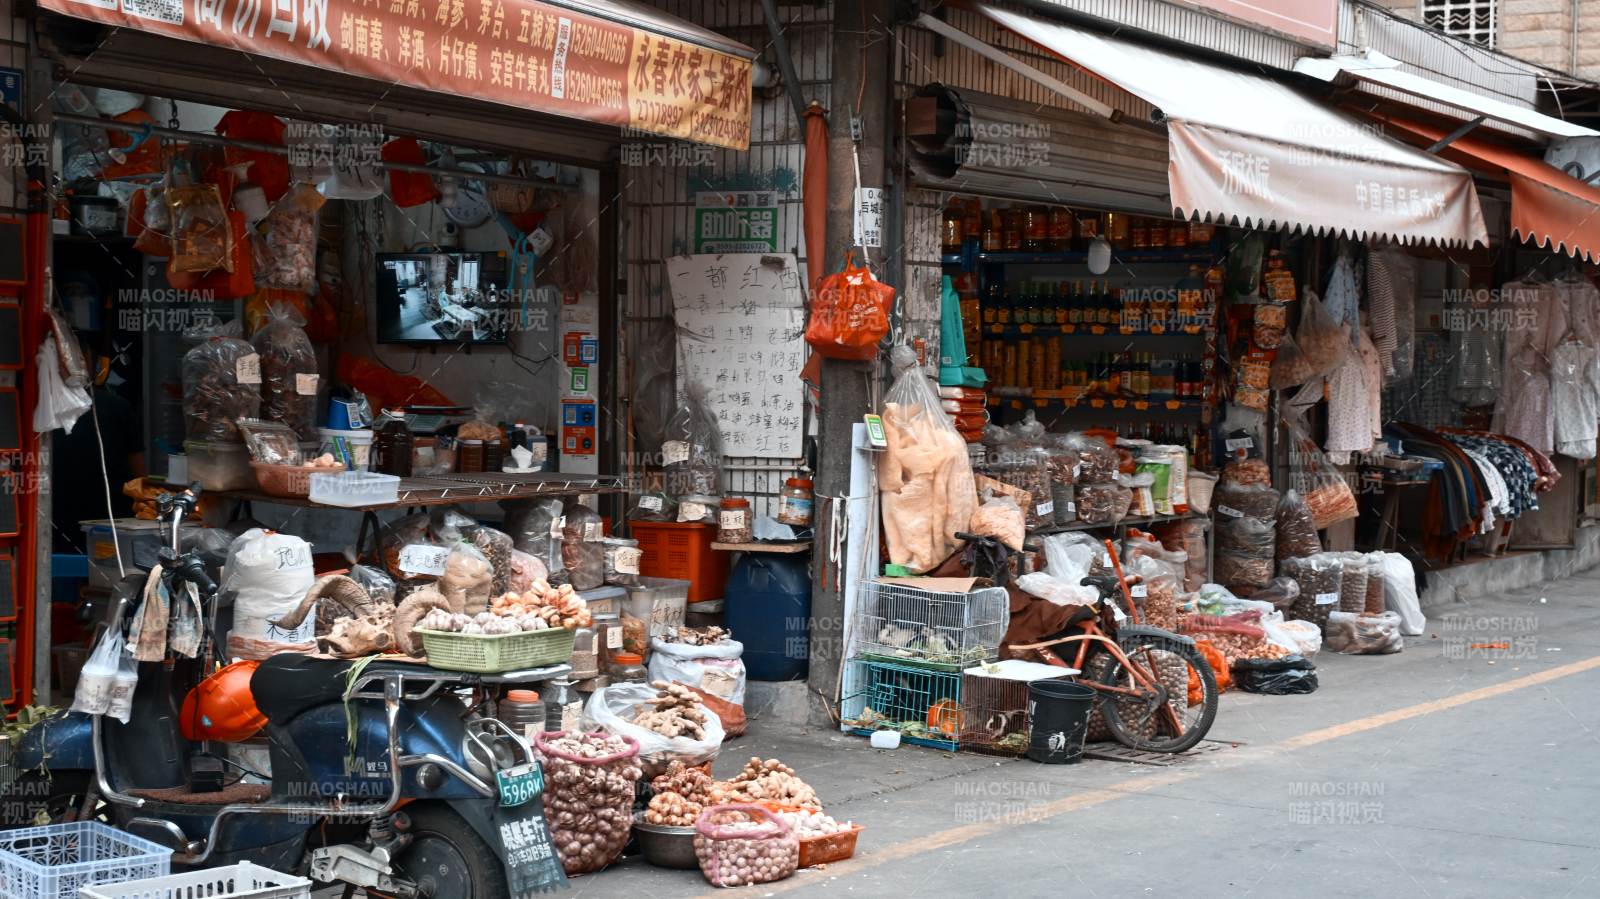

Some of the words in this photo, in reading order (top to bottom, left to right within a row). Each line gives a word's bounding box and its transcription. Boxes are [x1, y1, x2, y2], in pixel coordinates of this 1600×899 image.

[570, 22, 628, 65] 15260440666
[634, 34, 749, 115] 永春农家土猪肉
